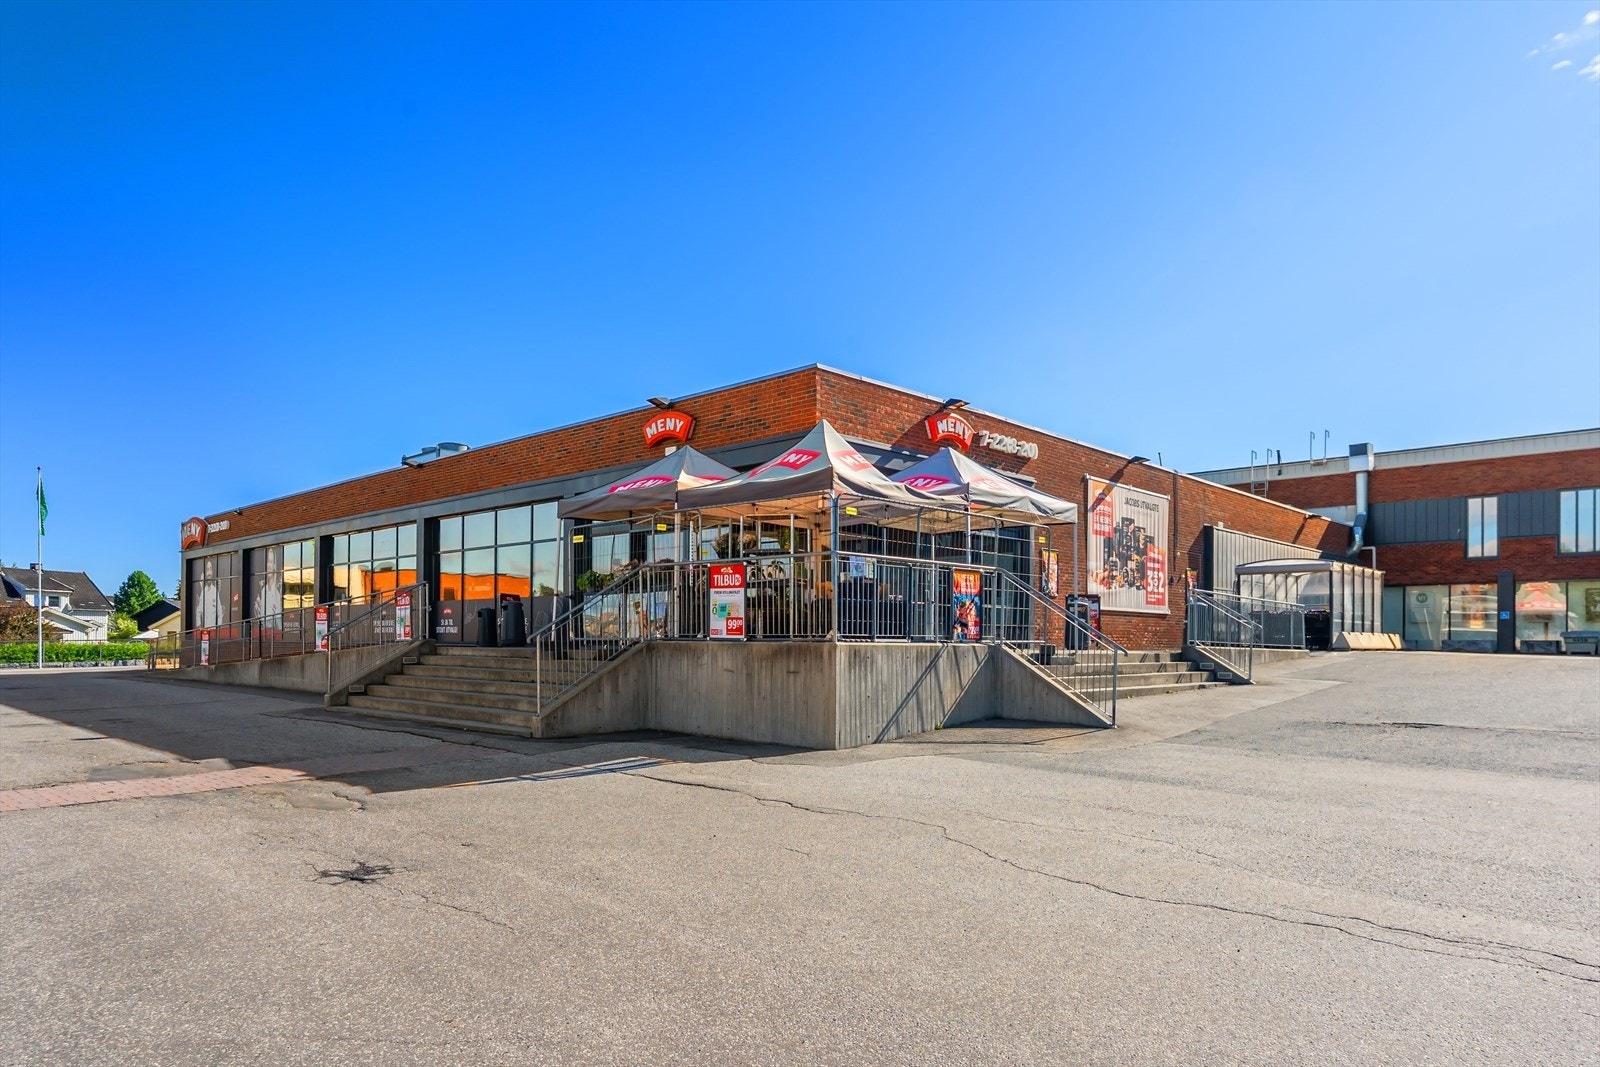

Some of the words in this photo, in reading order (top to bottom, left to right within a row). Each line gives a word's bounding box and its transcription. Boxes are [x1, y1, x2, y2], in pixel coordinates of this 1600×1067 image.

[646, 418, 684, 439] MENY
[937, 418, 972, 440] MENY
[840, 453, 867, 468] ME
[713, 574, 741, 586] TILBUD
